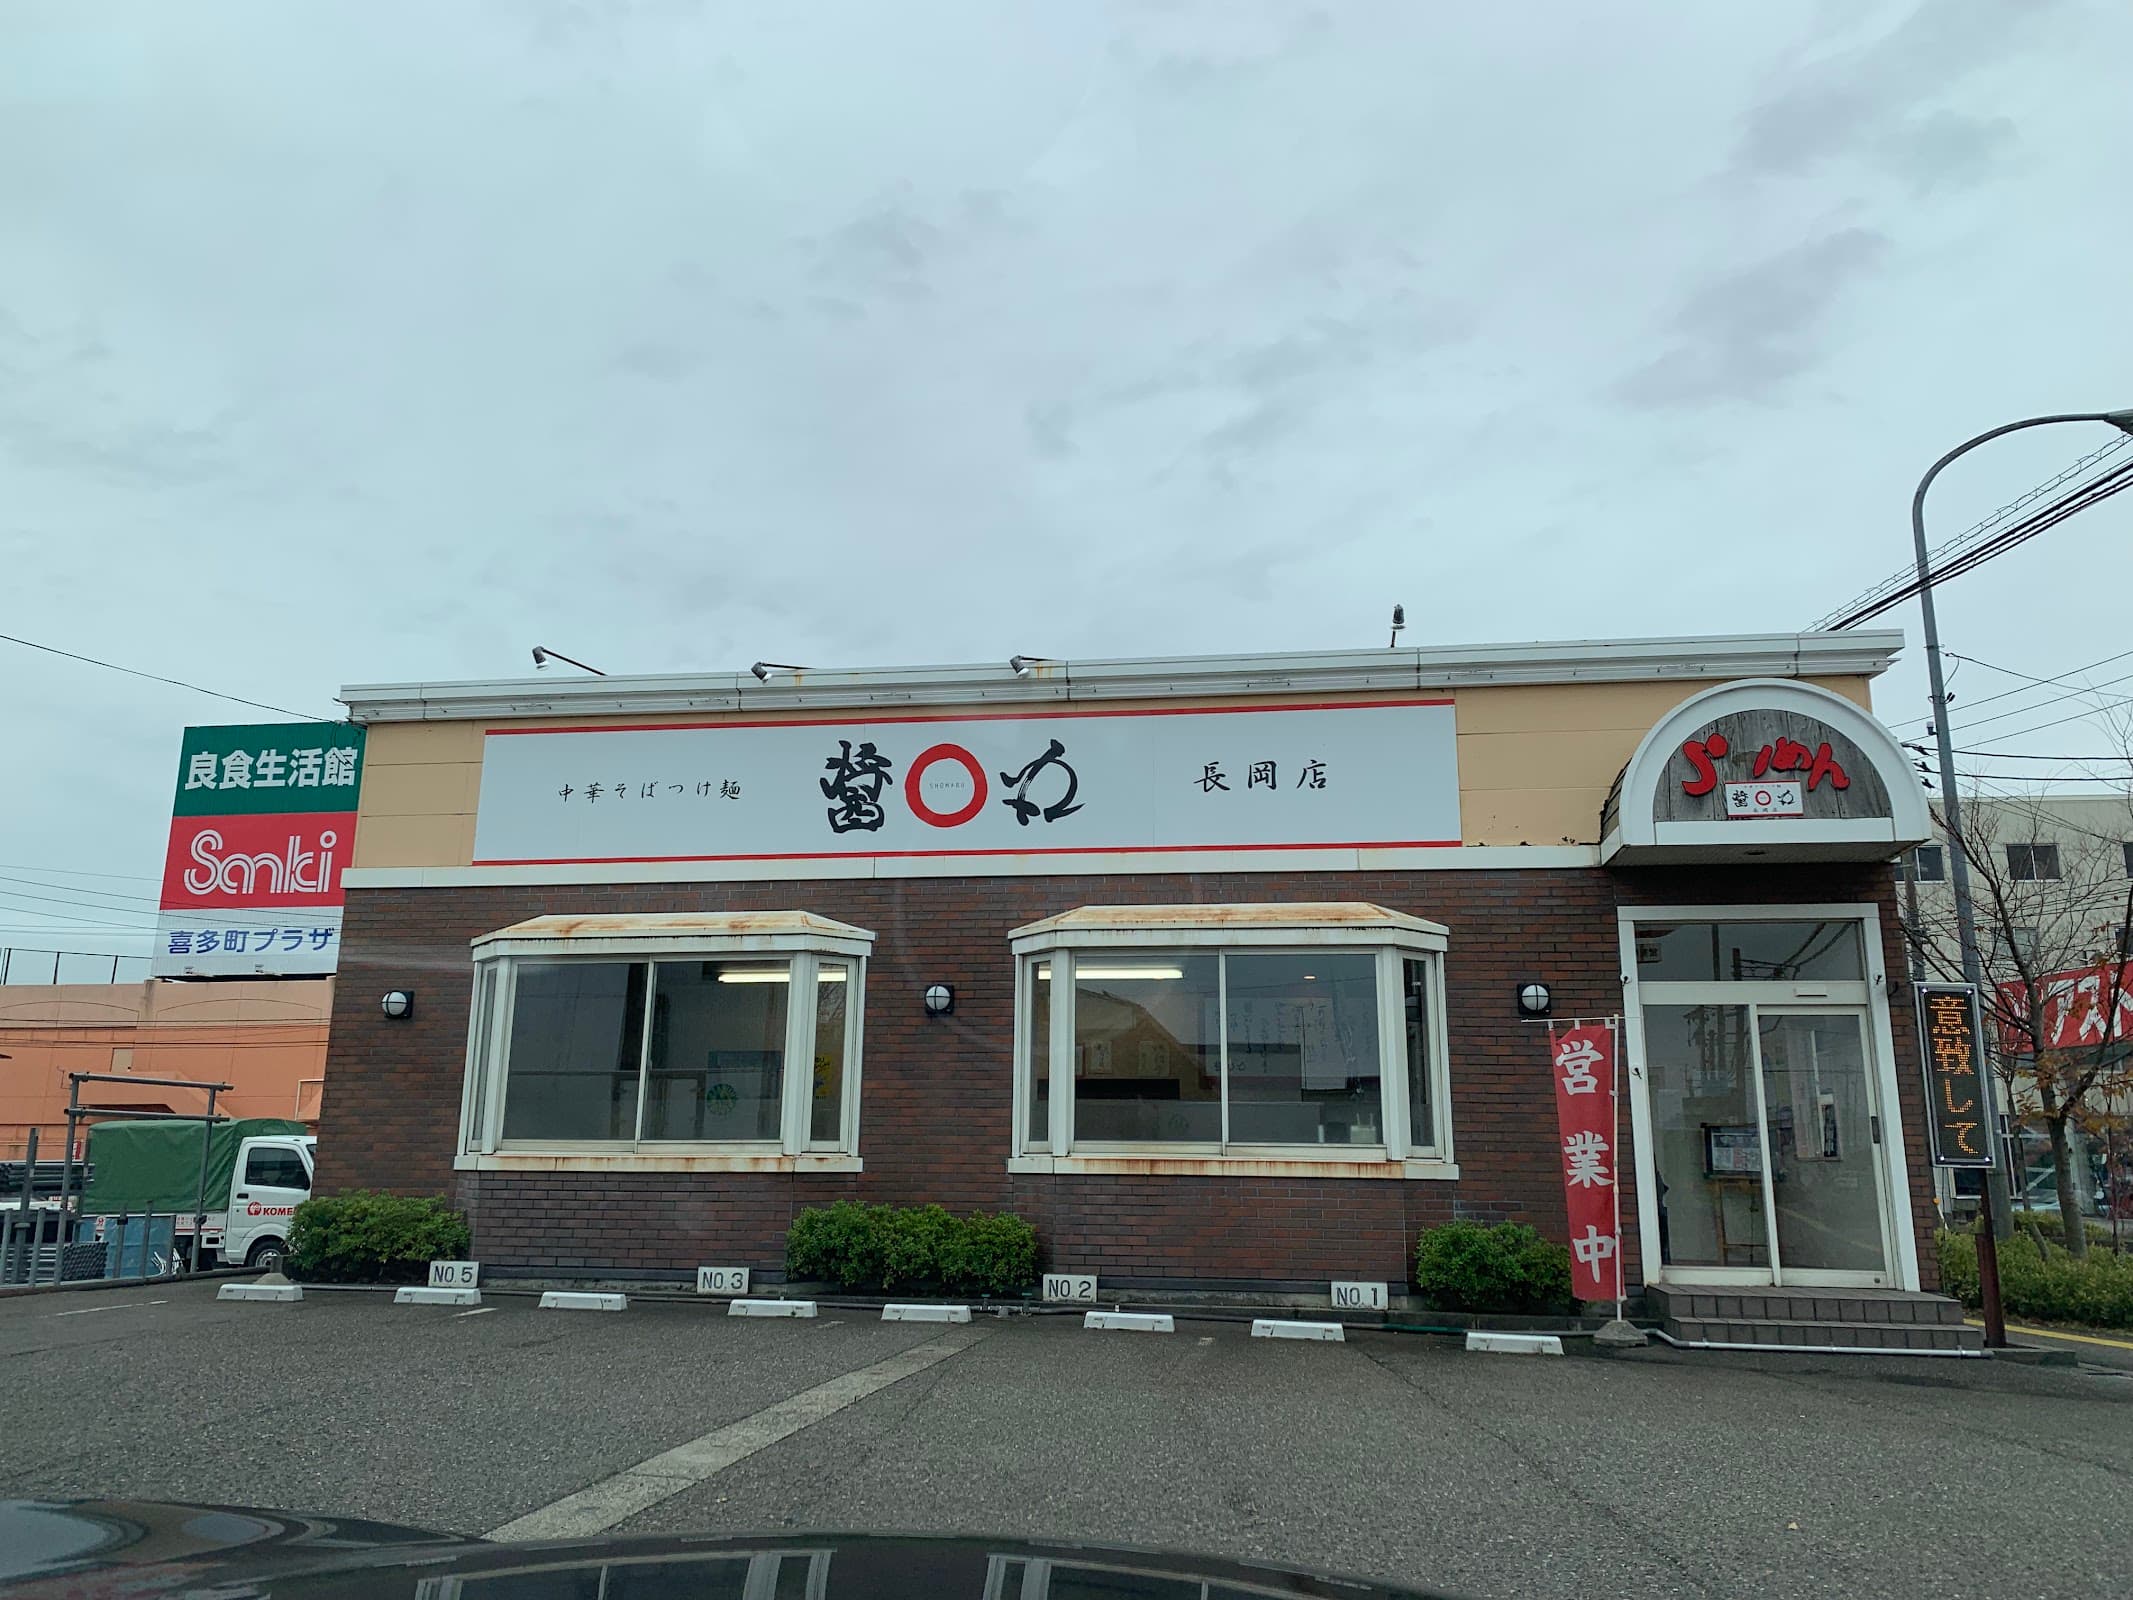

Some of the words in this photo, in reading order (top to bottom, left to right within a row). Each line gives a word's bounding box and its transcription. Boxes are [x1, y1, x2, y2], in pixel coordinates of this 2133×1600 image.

[184, 747, 358, 790] 良食生活館
[1194, 759, 1329, 793] 長岡店
[558, 779, 741, 804] 中華そばつけ麺
[184, 829, 337, 895] Sanki
[168, 927, 335, 954] 喜多町プラザ
[1556, 1039, 1615, 1285] 営業中
